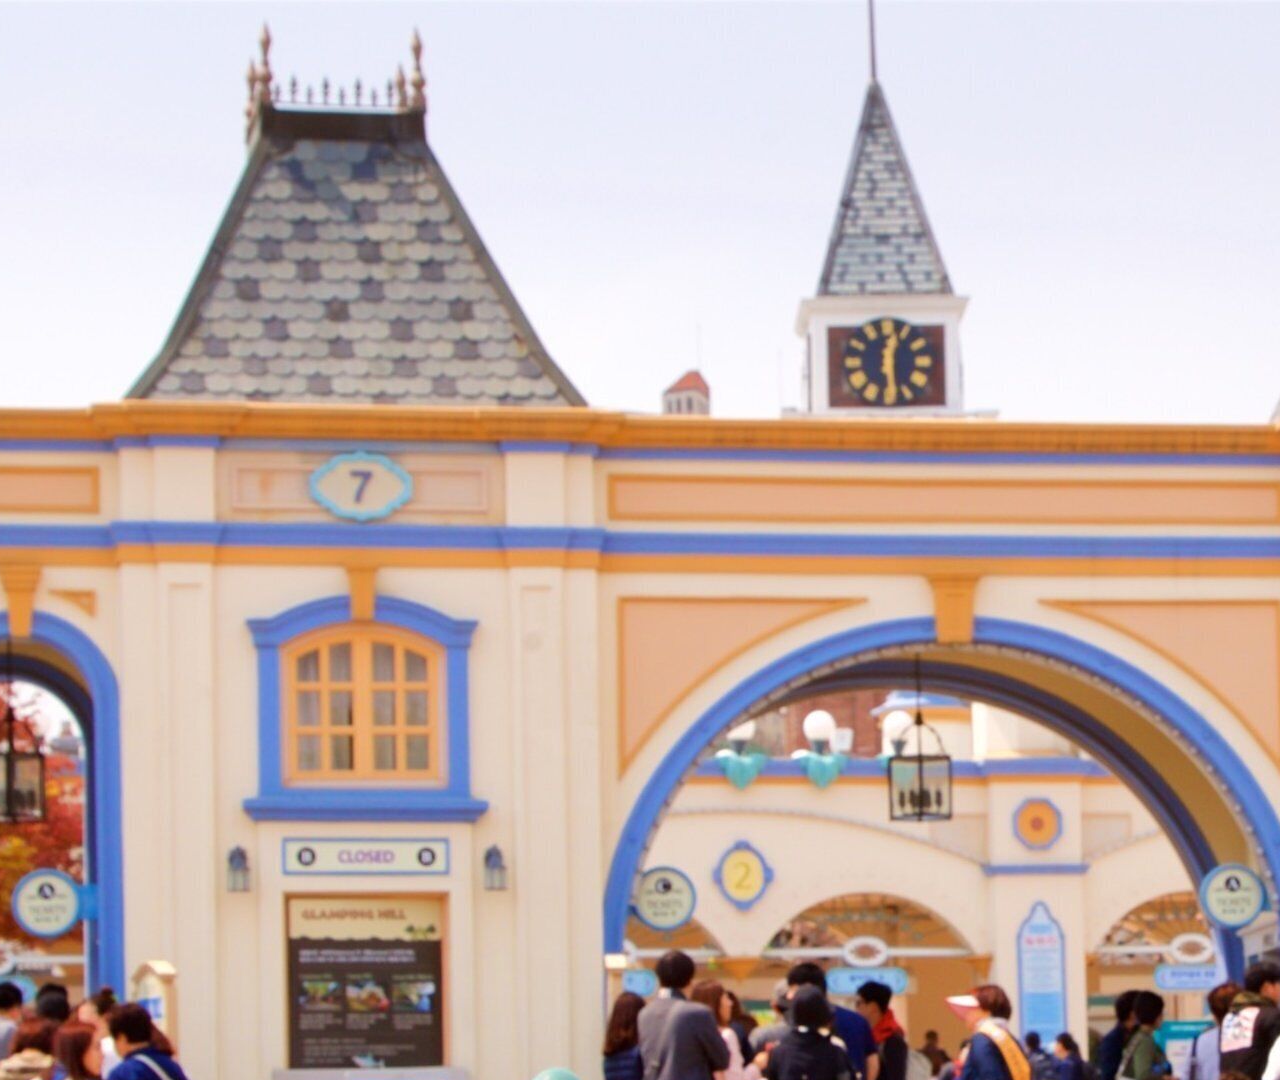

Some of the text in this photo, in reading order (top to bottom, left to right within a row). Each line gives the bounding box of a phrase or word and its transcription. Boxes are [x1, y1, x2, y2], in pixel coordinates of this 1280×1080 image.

[350, 470, 372, 503] 7
[338, 850, 395, 864] CLOSED
[734, 861, 752, 890] 2
[302, 908, 406, 920] GLAMPING HILL
